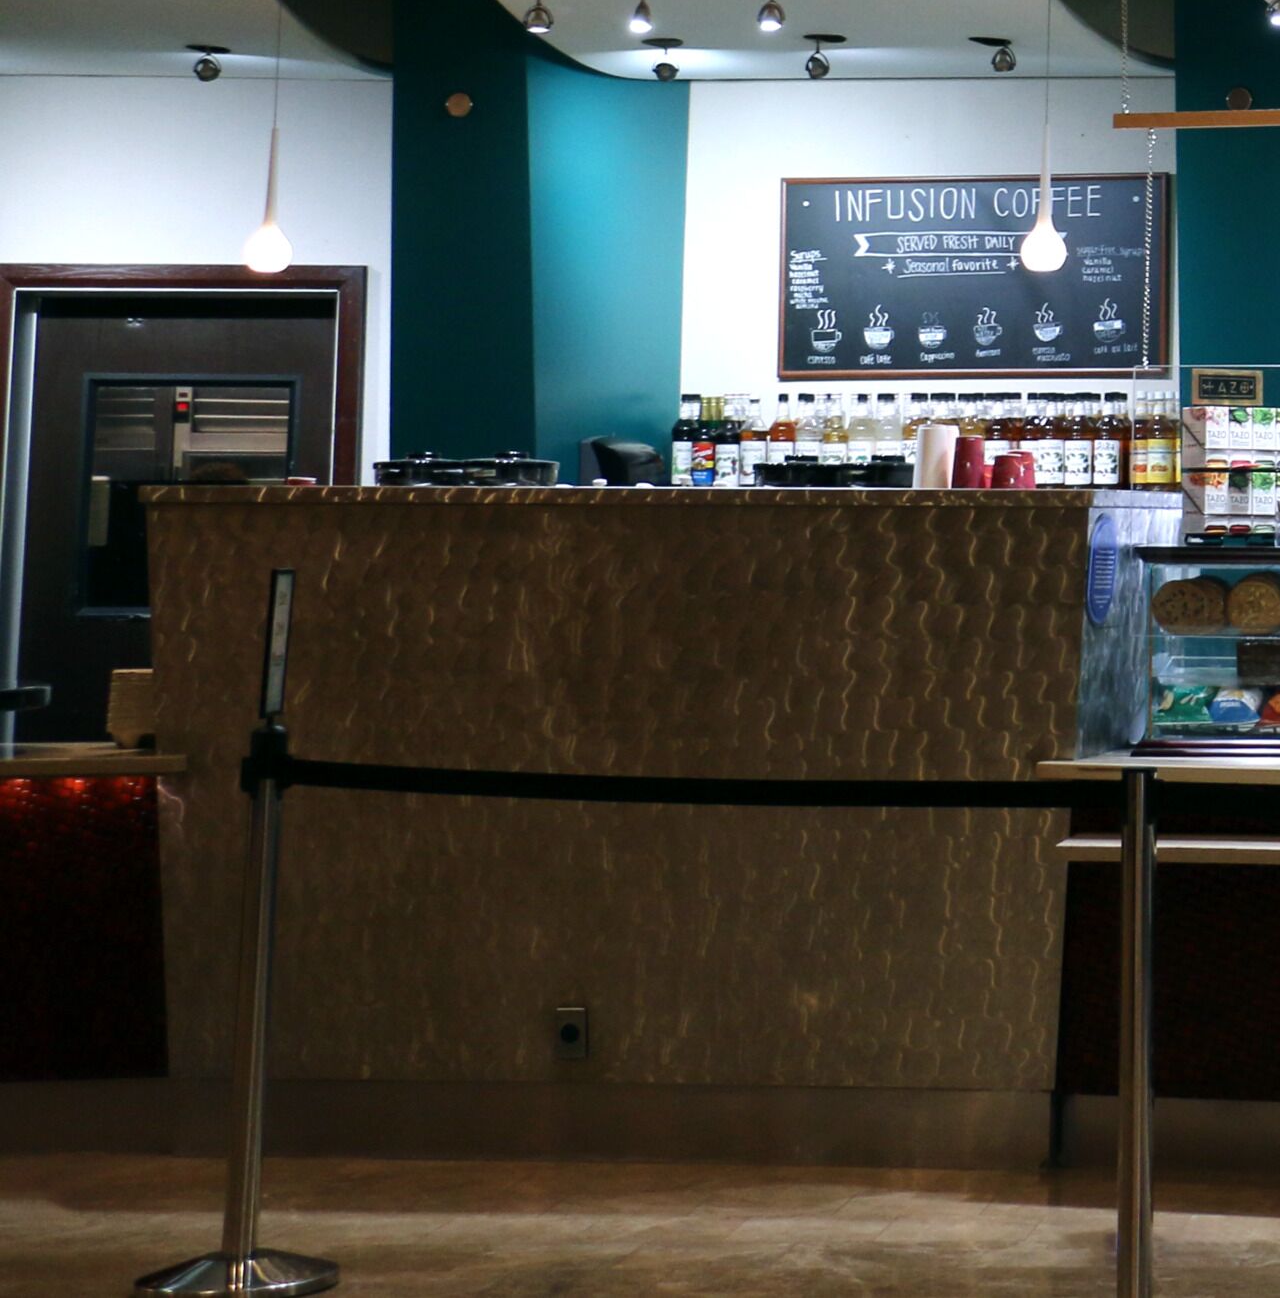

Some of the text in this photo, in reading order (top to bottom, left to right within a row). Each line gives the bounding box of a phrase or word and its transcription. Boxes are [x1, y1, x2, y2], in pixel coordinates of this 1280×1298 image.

[834, 185, 1102, 222] INFUSION COFFEE
[896, 235, 1016, 252] SERVED FRESH DAILY
[903, 258, 999, 274] Seasonal favorite
[1208, 431, 1227, 439] TAZO
[1231, 431, 1249, 439] TAZO
[1255, 431, 1273, 440] TAZO
[1207, 494, 1225, 502] TAZO
[1254, 496, 1273, 504] TAZO
